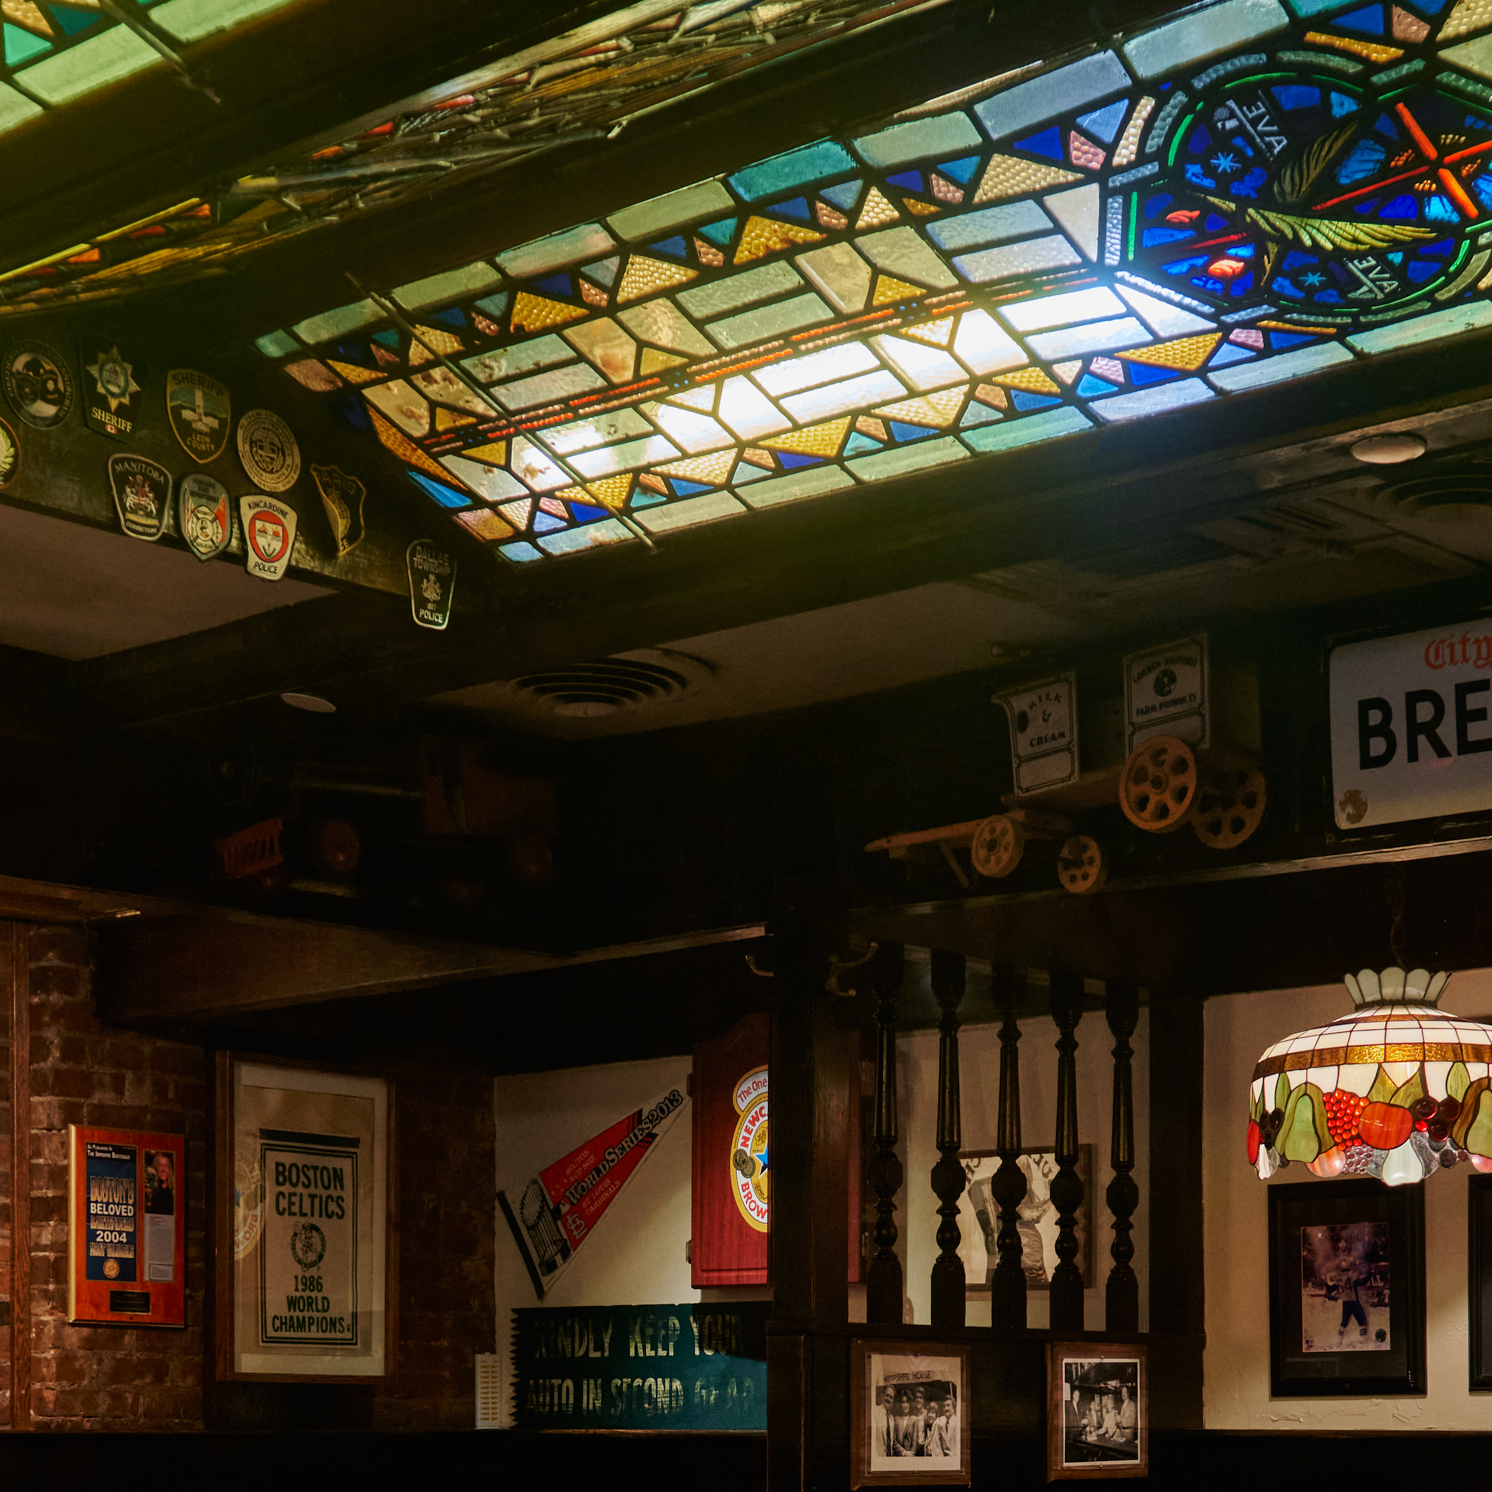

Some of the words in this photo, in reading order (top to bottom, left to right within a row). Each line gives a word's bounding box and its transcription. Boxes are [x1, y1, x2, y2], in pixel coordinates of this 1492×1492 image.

[171, 372, 225, 398] SHERIFF
[91, 406, 133, 433] SHERIFF
[186, 438, 215, 452] COUNTY
[192, 432, 210, 443] LEON
[115, 461, 164, 485] MANITOBA
[248, 501, 289, 519] KINCARDINE
[415, 545, 449, 565] DALLAS
[253, 562, 279, 576] POLICE
[413, 557, 451, 574] TOWNSHIP
[419, 608, 444, 624] POLICE
[1028, 691, 1063, 710] MILK
[1136, 703, 1157, 717] FARM
[1159, 692, 1197, 712] PRODUCTS
[1041, 709, 1053, 723] &
[1029, 730, 1066, 748] CREAM
[737, 1086, 752, 1103] The
[752, 1078, 767, 1092] One
[740, 1106, 768, 1149] NEWC
[565, 1159, 611, 1203] WORLD
[604, 1120, 653, 1168] SERIES
[648, 1089, 685, 1127] 2013
[565, 1148, 590, 1176] BOSTON
[581, 1154, 596, 1170] SOX
[275, 1161, 345, 1191] BOSTON
[90, 1176, 134, 1204] BOSTON'S
[585, 1180, 622, 1216] CARDINALS
[593, 1178, 612, 1200] LOUIS
[90, 1203, 134, 1216] BELOVED
[275, 1191, 345, 1220] CELTICS
[96, 1231, 127, 1243] 2004
[294, 1275, 323, 1292] 1986
[286, 1295, 330, 1313] WORLD
[272, 1315, 345, 1334] CHAMPIONS
[534, 1316, 613, 1359] KINDLY
[628, 1315, 681, 1358] KEEP
[689, 1313, 744, 1357] YOUR
[912, 1369, 932, 1381] HOUSE
[526, 1377, 575, 1415] AUTO
[582, 1377, 603, 1416] IN
[610, 1377, 685, 1416] SECOND
[694, 1376, 755, 1412] GEAR
